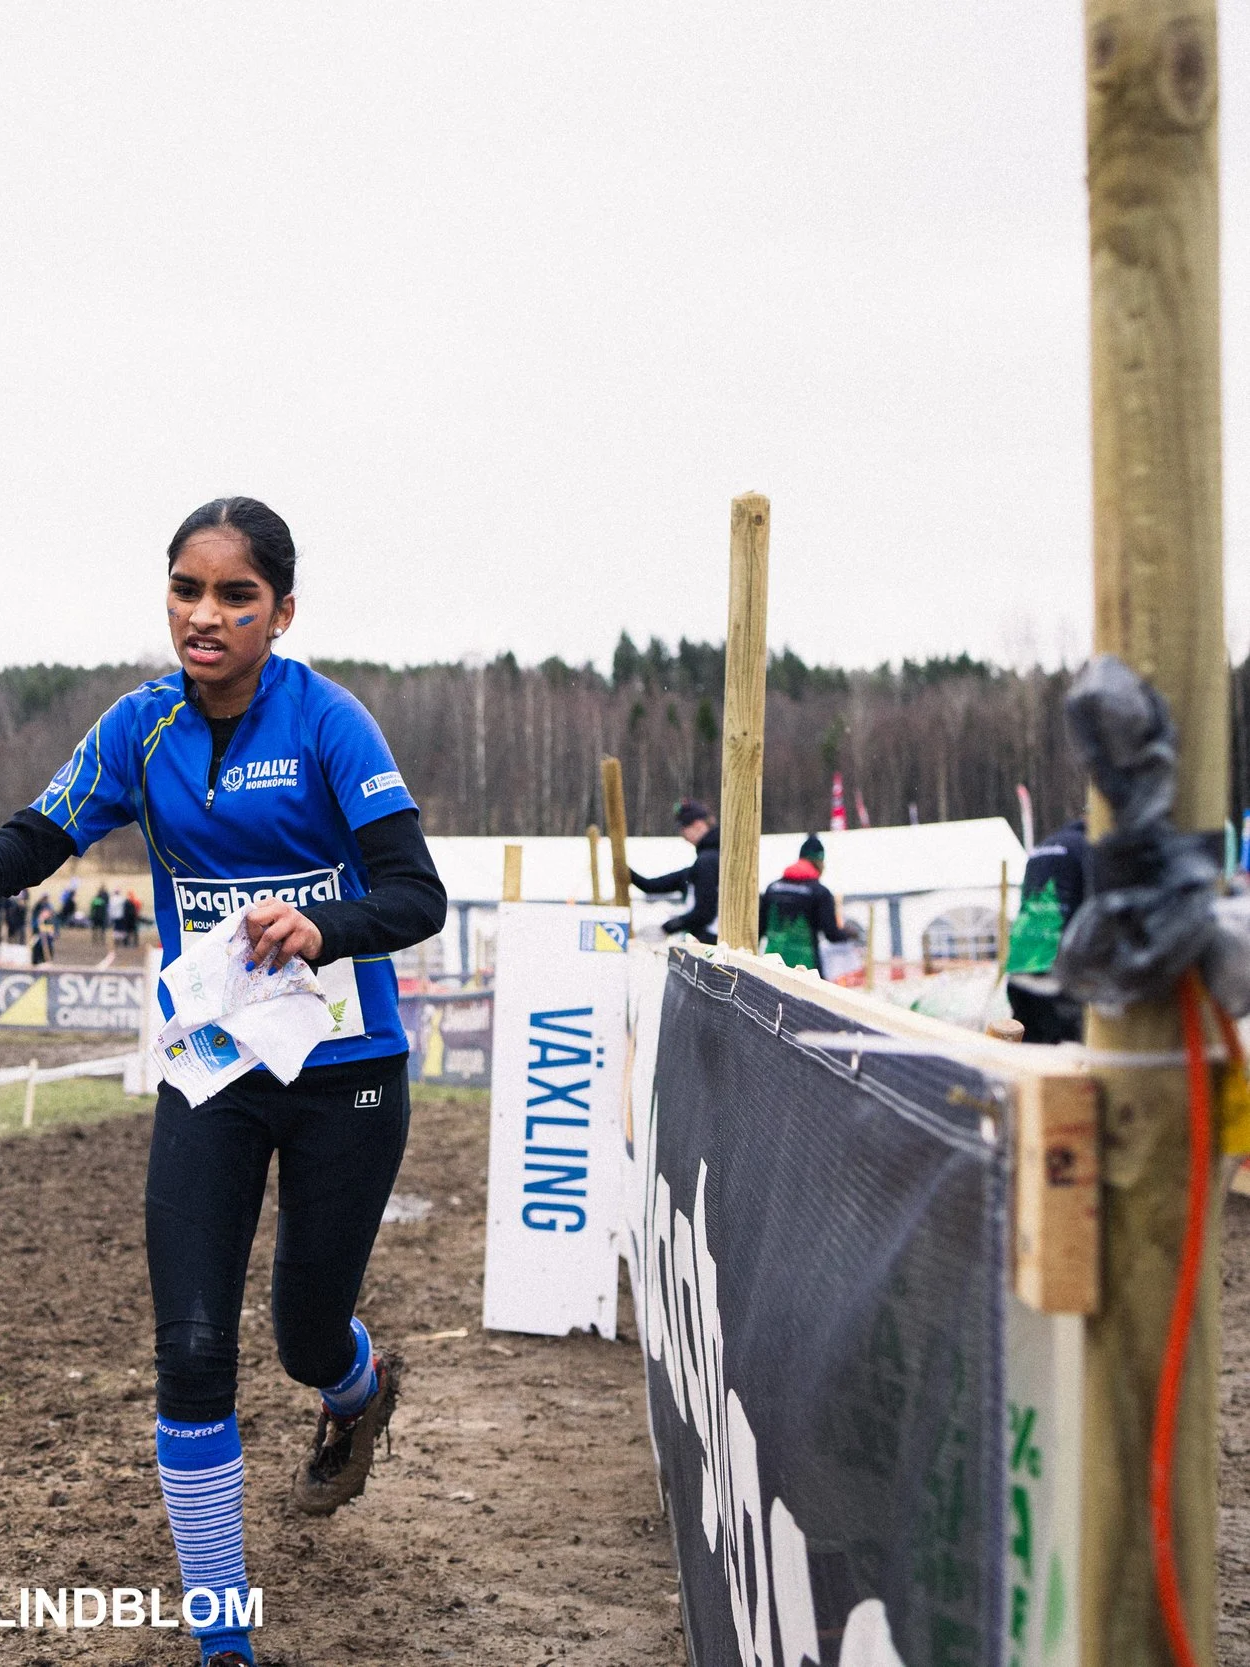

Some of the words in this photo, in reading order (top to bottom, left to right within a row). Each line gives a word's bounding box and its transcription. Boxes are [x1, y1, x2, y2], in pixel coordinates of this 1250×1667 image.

[246, 759, 299, 779] TJALVE
[245, 776, 298, 790] NORRKÖPING
[521, 1007, 604, 1233] VÄXLING
